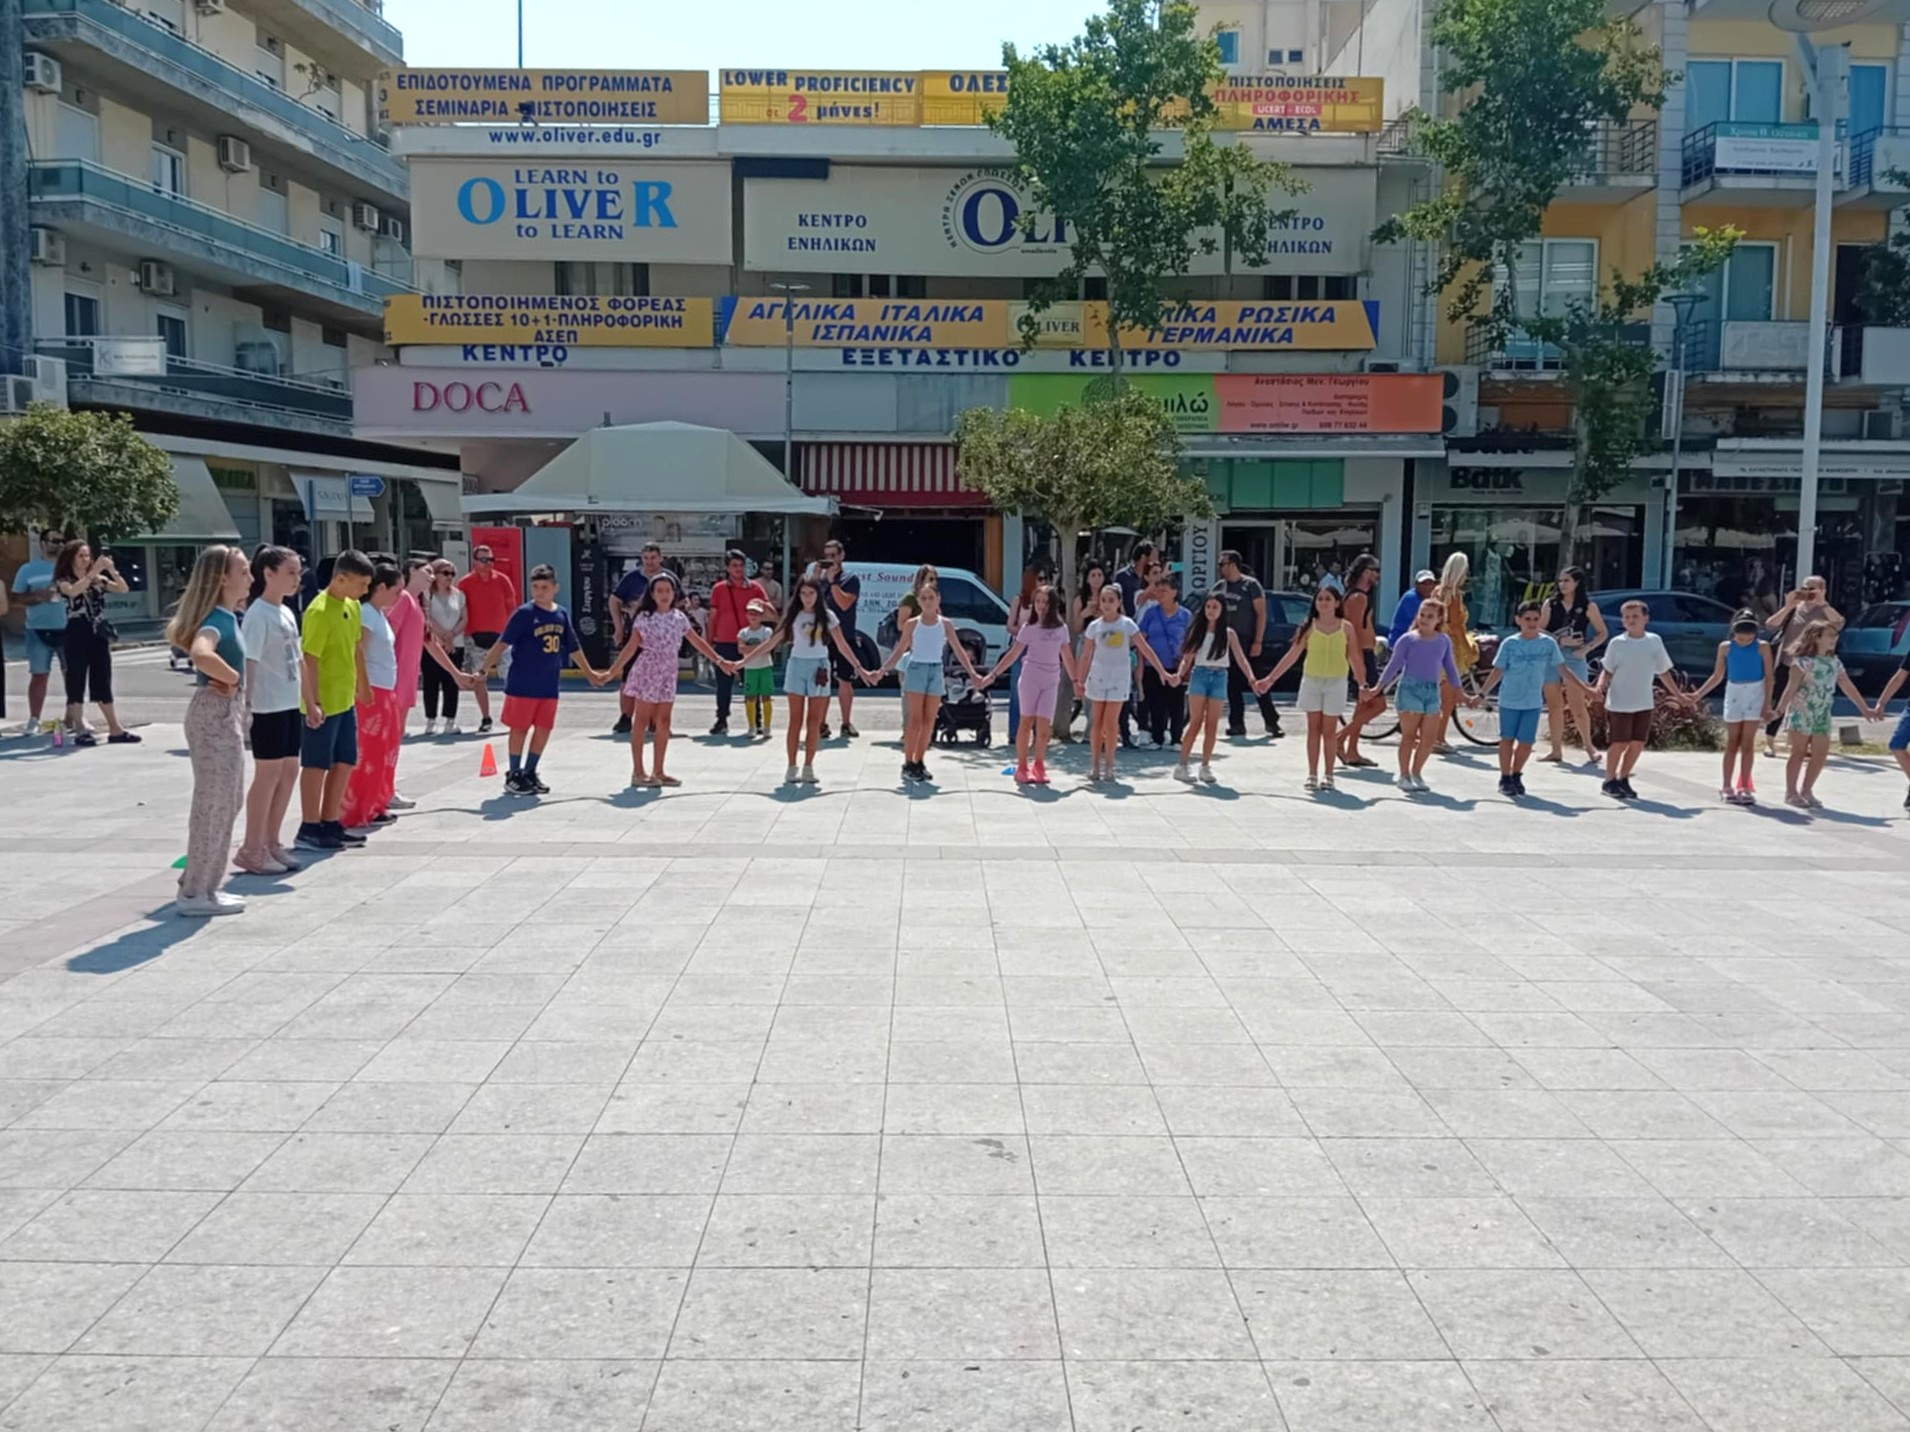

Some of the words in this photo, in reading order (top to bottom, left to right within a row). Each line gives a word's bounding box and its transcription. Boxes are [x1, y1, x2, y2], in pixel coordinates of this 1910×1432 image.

[397, 74, 532, 91] ΕΠΙΔΟΤΟΥΜΕΝΑ
[542, 75, 673, 92] ΠΡΟΓΡΑΜΜΑΤΑ
[725, 70, 788, 87] LOWER
[795, 76, 915, 93] PROFICIENCY
[1229, 76, 1346, 90] ΠΙΣΤΟΠΟΙΗΣΕΙΣ
[1214, 90, 1360, 104] ΠΛΗΡΟΦΟΡΙΚΗΣ
[415, 100, 509, 117] ΣΕΜΙΝΑΡΙΑ
[787, 94, 808, 122] 2
[1252, 117, 1322, 131] ΑΜΕΣΑ
[489, 127, 661, 148] www.oliver.edu.gr
[515, 169, 588, 185] LEARN
[597, 170, 619, 185] to
[457, 176, 678, 229] OLIVER
[798, 213, 868, 229] ΚΕΝΤΡΟ
[1266, 216, 1325, 231] ΕΝΤΡΟ
[516, 225, 538, 239] to
[551, 224, 624, 240] LEARN
[787, 237, 877, 252] ΕΝΗΛΙΚΩΝ
[1266, 240, 1333, 254] ΗΛΙΚΩΝ
[422, 295, 600, 312] ΠΙΣΤΟΠΟΙΗΜΕΝΟΣ
[607, 298, 687, 313] ΦΟΡΕΑΣ
[880, 305, 985, 323] ΙΤΑΛΙΚΑ
[1238, 306, 1336, 324] ΡΩΣΙΚΑ
[534, 330, 578, 344] ΑΣΕΠ
[811, 324, 933, 343] ΙΣΠΑΝΙΚΑ
[462, 345, 568, 363] ΚΕΝΤΡΟ
[842, 349, 1020, 367] ΕΞΕΤΑΣΤΙΚΟ
[412, 381, 531, 414] DOCA
[1191, 526, 1208, 589] ΩΡΓΙΟΥ
